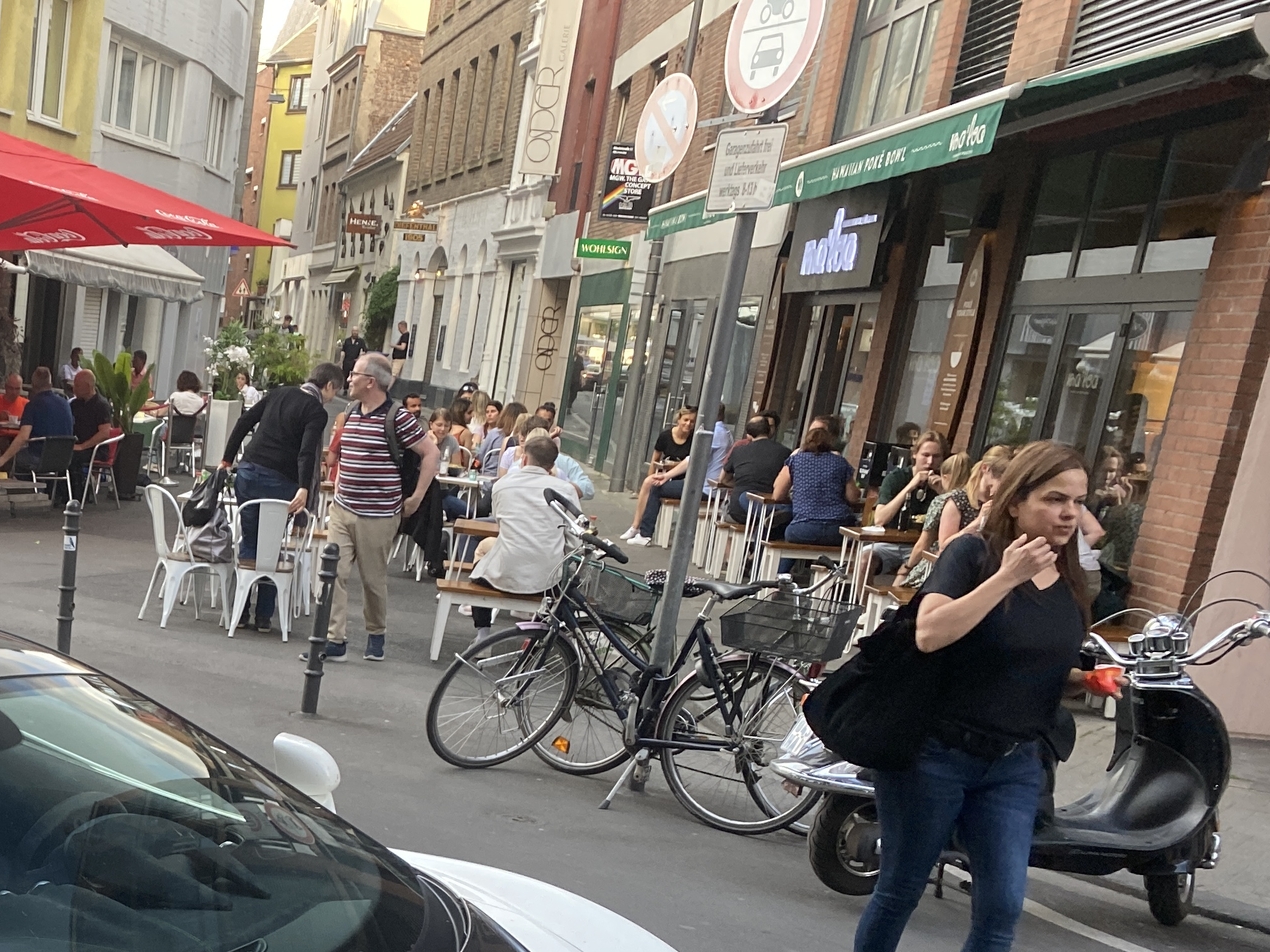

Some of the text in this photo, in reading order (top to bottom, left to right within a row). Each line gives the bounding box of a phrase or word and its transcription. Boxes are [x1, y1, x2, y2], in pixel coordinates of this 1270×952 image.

[559, 24, 571, 63] GALERIE
[725, 137, 774, 159] Garagenzufahrt frei
[723, 161, 735, 177] und
[832, 159, 864, 182] HAWAIIAN
[885, 147, 907, 167] BOWL
[624, 181, 652, 190] CONCEPT
[718, 183, 741, 200] werktags
[581, 243, 628, 255] WOHLSIGN
